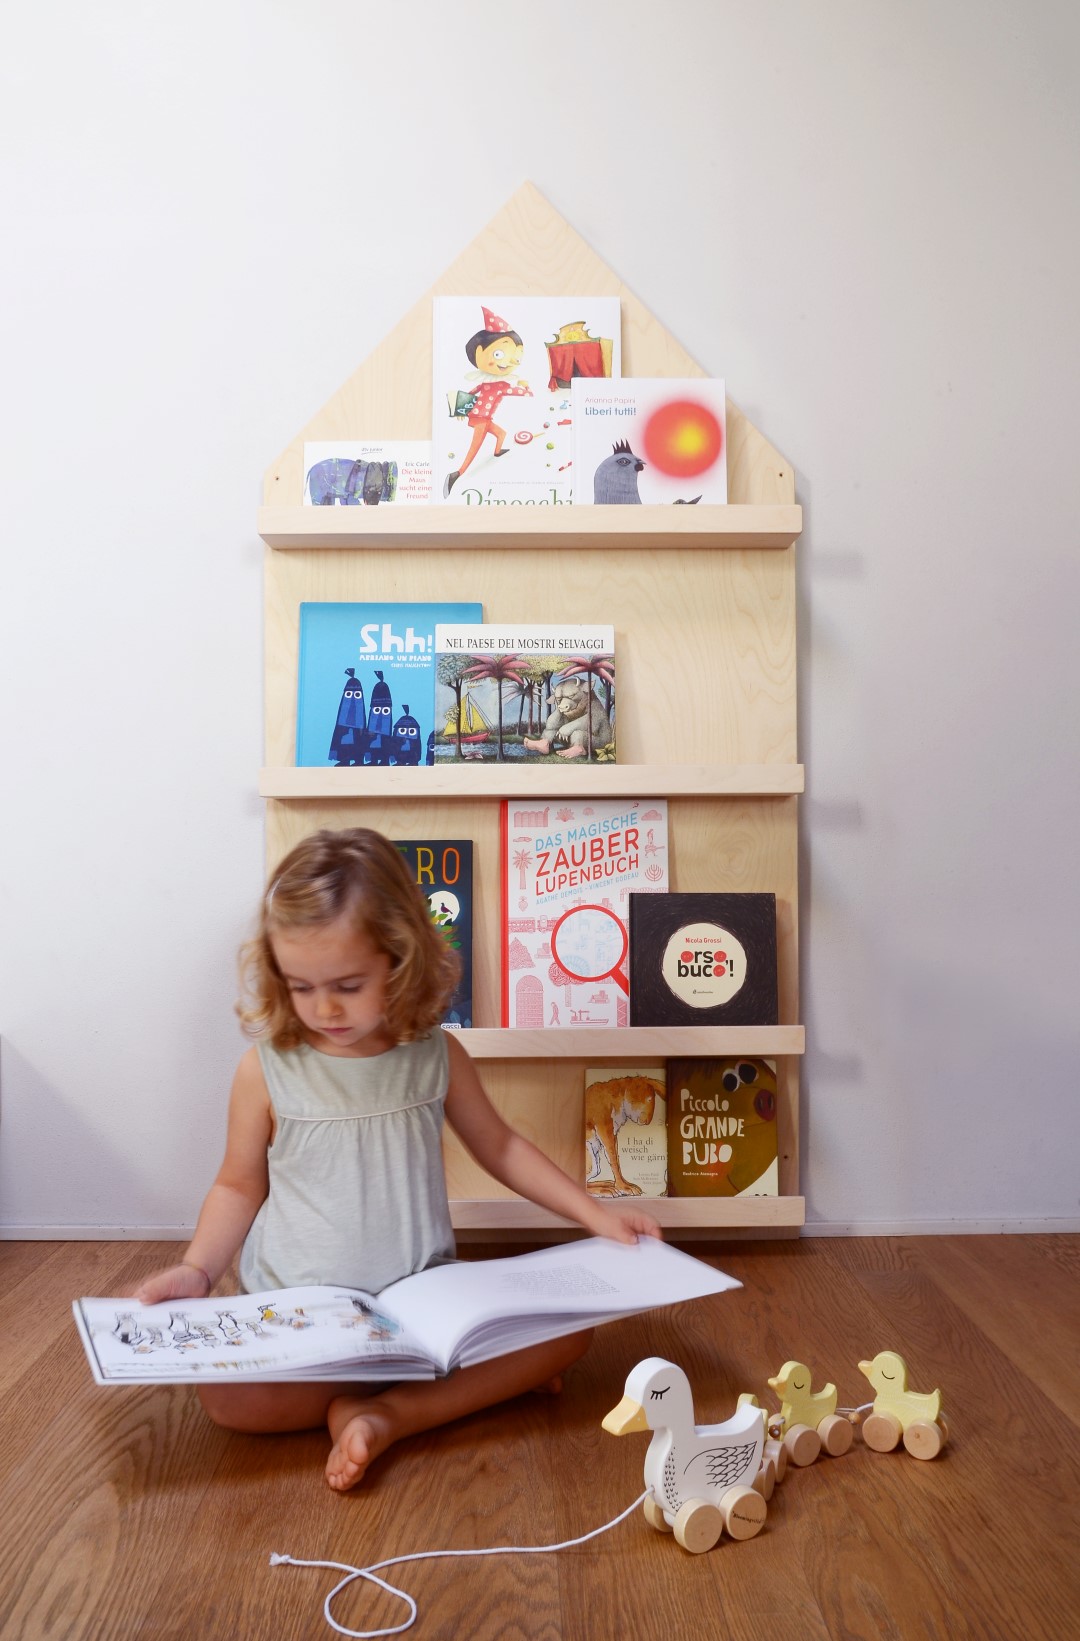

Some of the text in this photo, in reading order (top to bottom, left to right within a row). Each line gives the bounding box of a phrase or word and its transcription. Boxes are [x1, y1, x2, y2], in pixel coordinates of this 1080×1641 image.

[585, 407, 637, 416] Liberi tutti!
[614, 397, 636, 405] Papini
[359, 623, 433, 653] Shh!
[446, 638, 605, 649] NEL PAESE DEI MOSTRI SELVAGGI
[535, 812, 638, 852] DAS MAGISCHE
[536, 828, 639, 878] ZAUBER
[536, 853, 640, 897] LUPENBUCH
[536, 892, 559, 905] AGATHE
[589, 878, 614, 890] VINCENT
[680, 1088, 730, 1112] Piccolo
[680, 1114, 745, 1139] GRANDE
[621, 1145, 649, 1154] weisch
[633, 1136, 643, 1145] ha
[645, 1136, 654, 1145] di
[630, 1153, 666, 1163] wie gärn
[682, 1141, 733, 1165] BUBO
